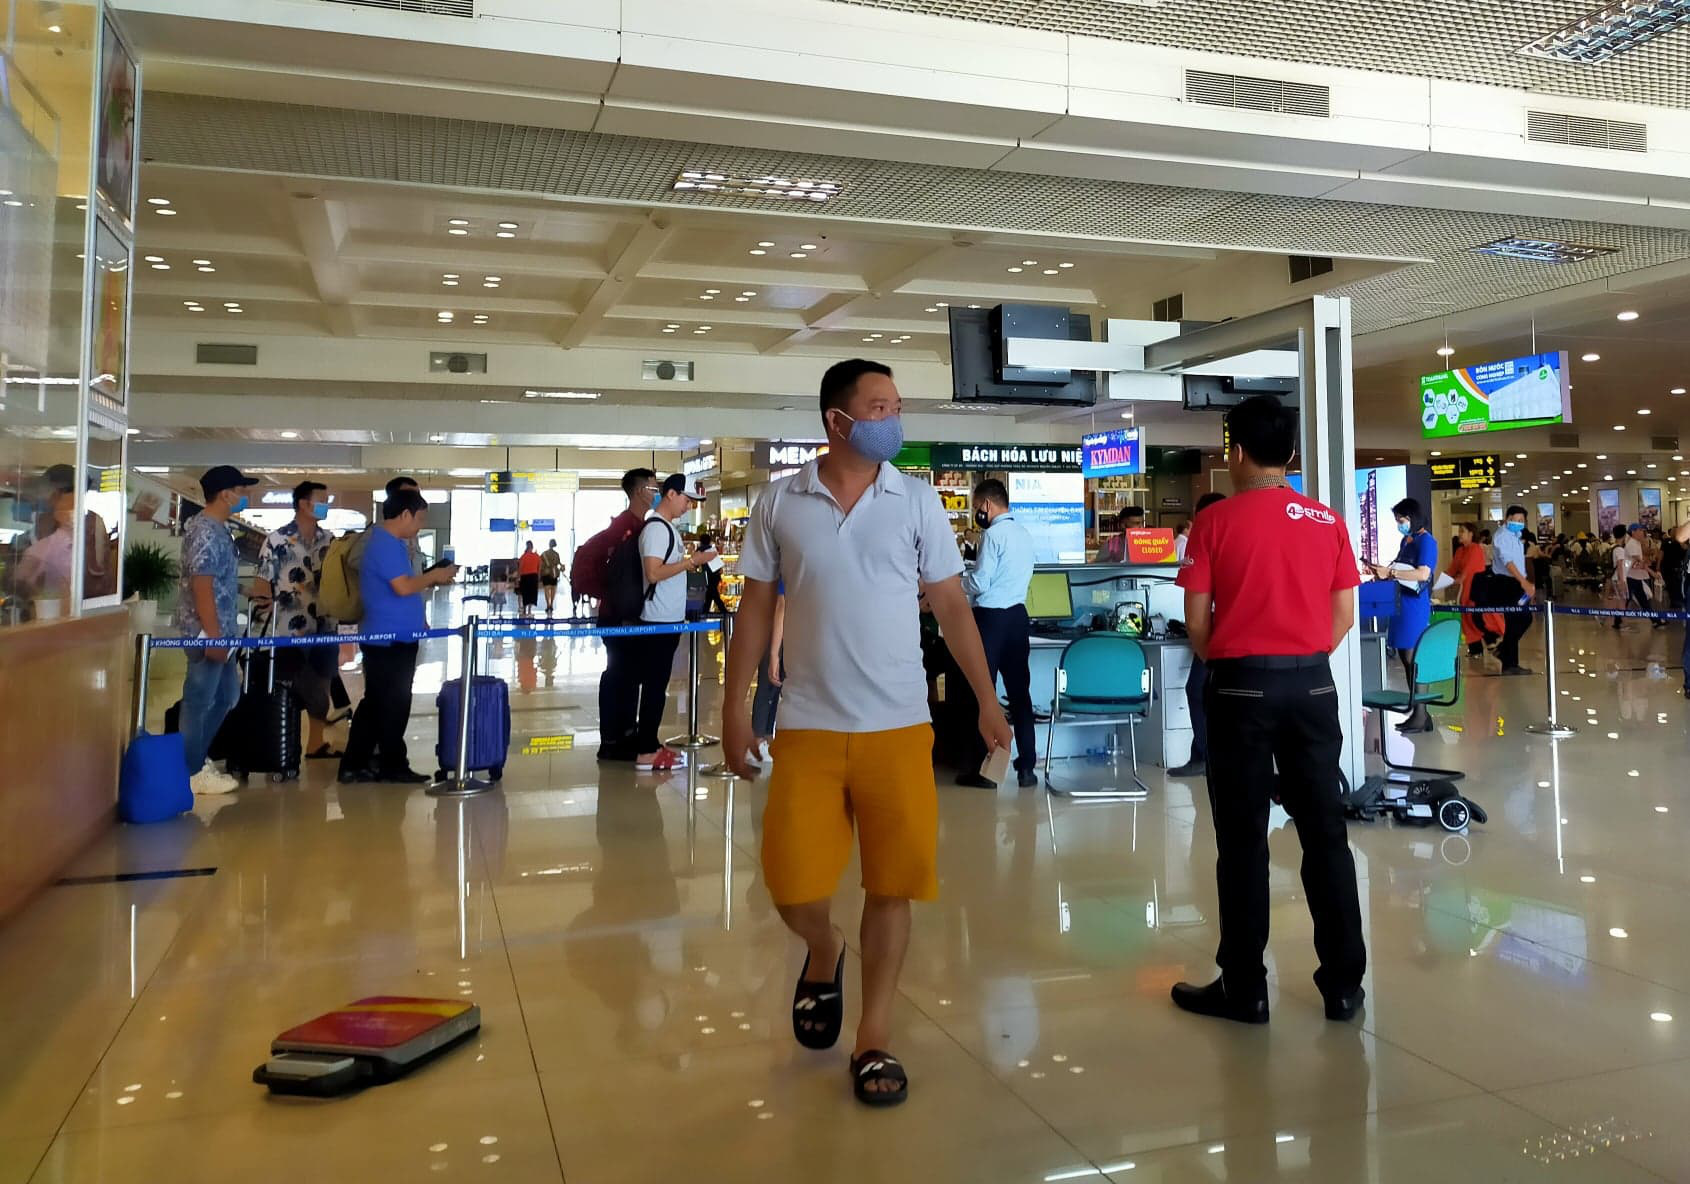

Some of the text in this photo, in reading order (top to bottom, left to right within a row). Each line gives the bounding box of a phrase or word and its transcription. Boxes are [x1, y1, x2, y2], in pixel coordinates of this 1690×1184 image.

[962, 446, 998, 462] BÁCH
[1001, 446, 1028, 462] HÓA
[1031, 448, 1057, 463] LƯU
[1090, 446, 1131, 465] KYMDAN
[1142, 546, 1163, 554] CLOSED
[155, 638, 181, 647] KHÔNG
[183, 638, 203, 647] QUỐC
[315, 634, 366, 644] INTERNATIONAL
[369, 632, 397, 641] AIRPORT
